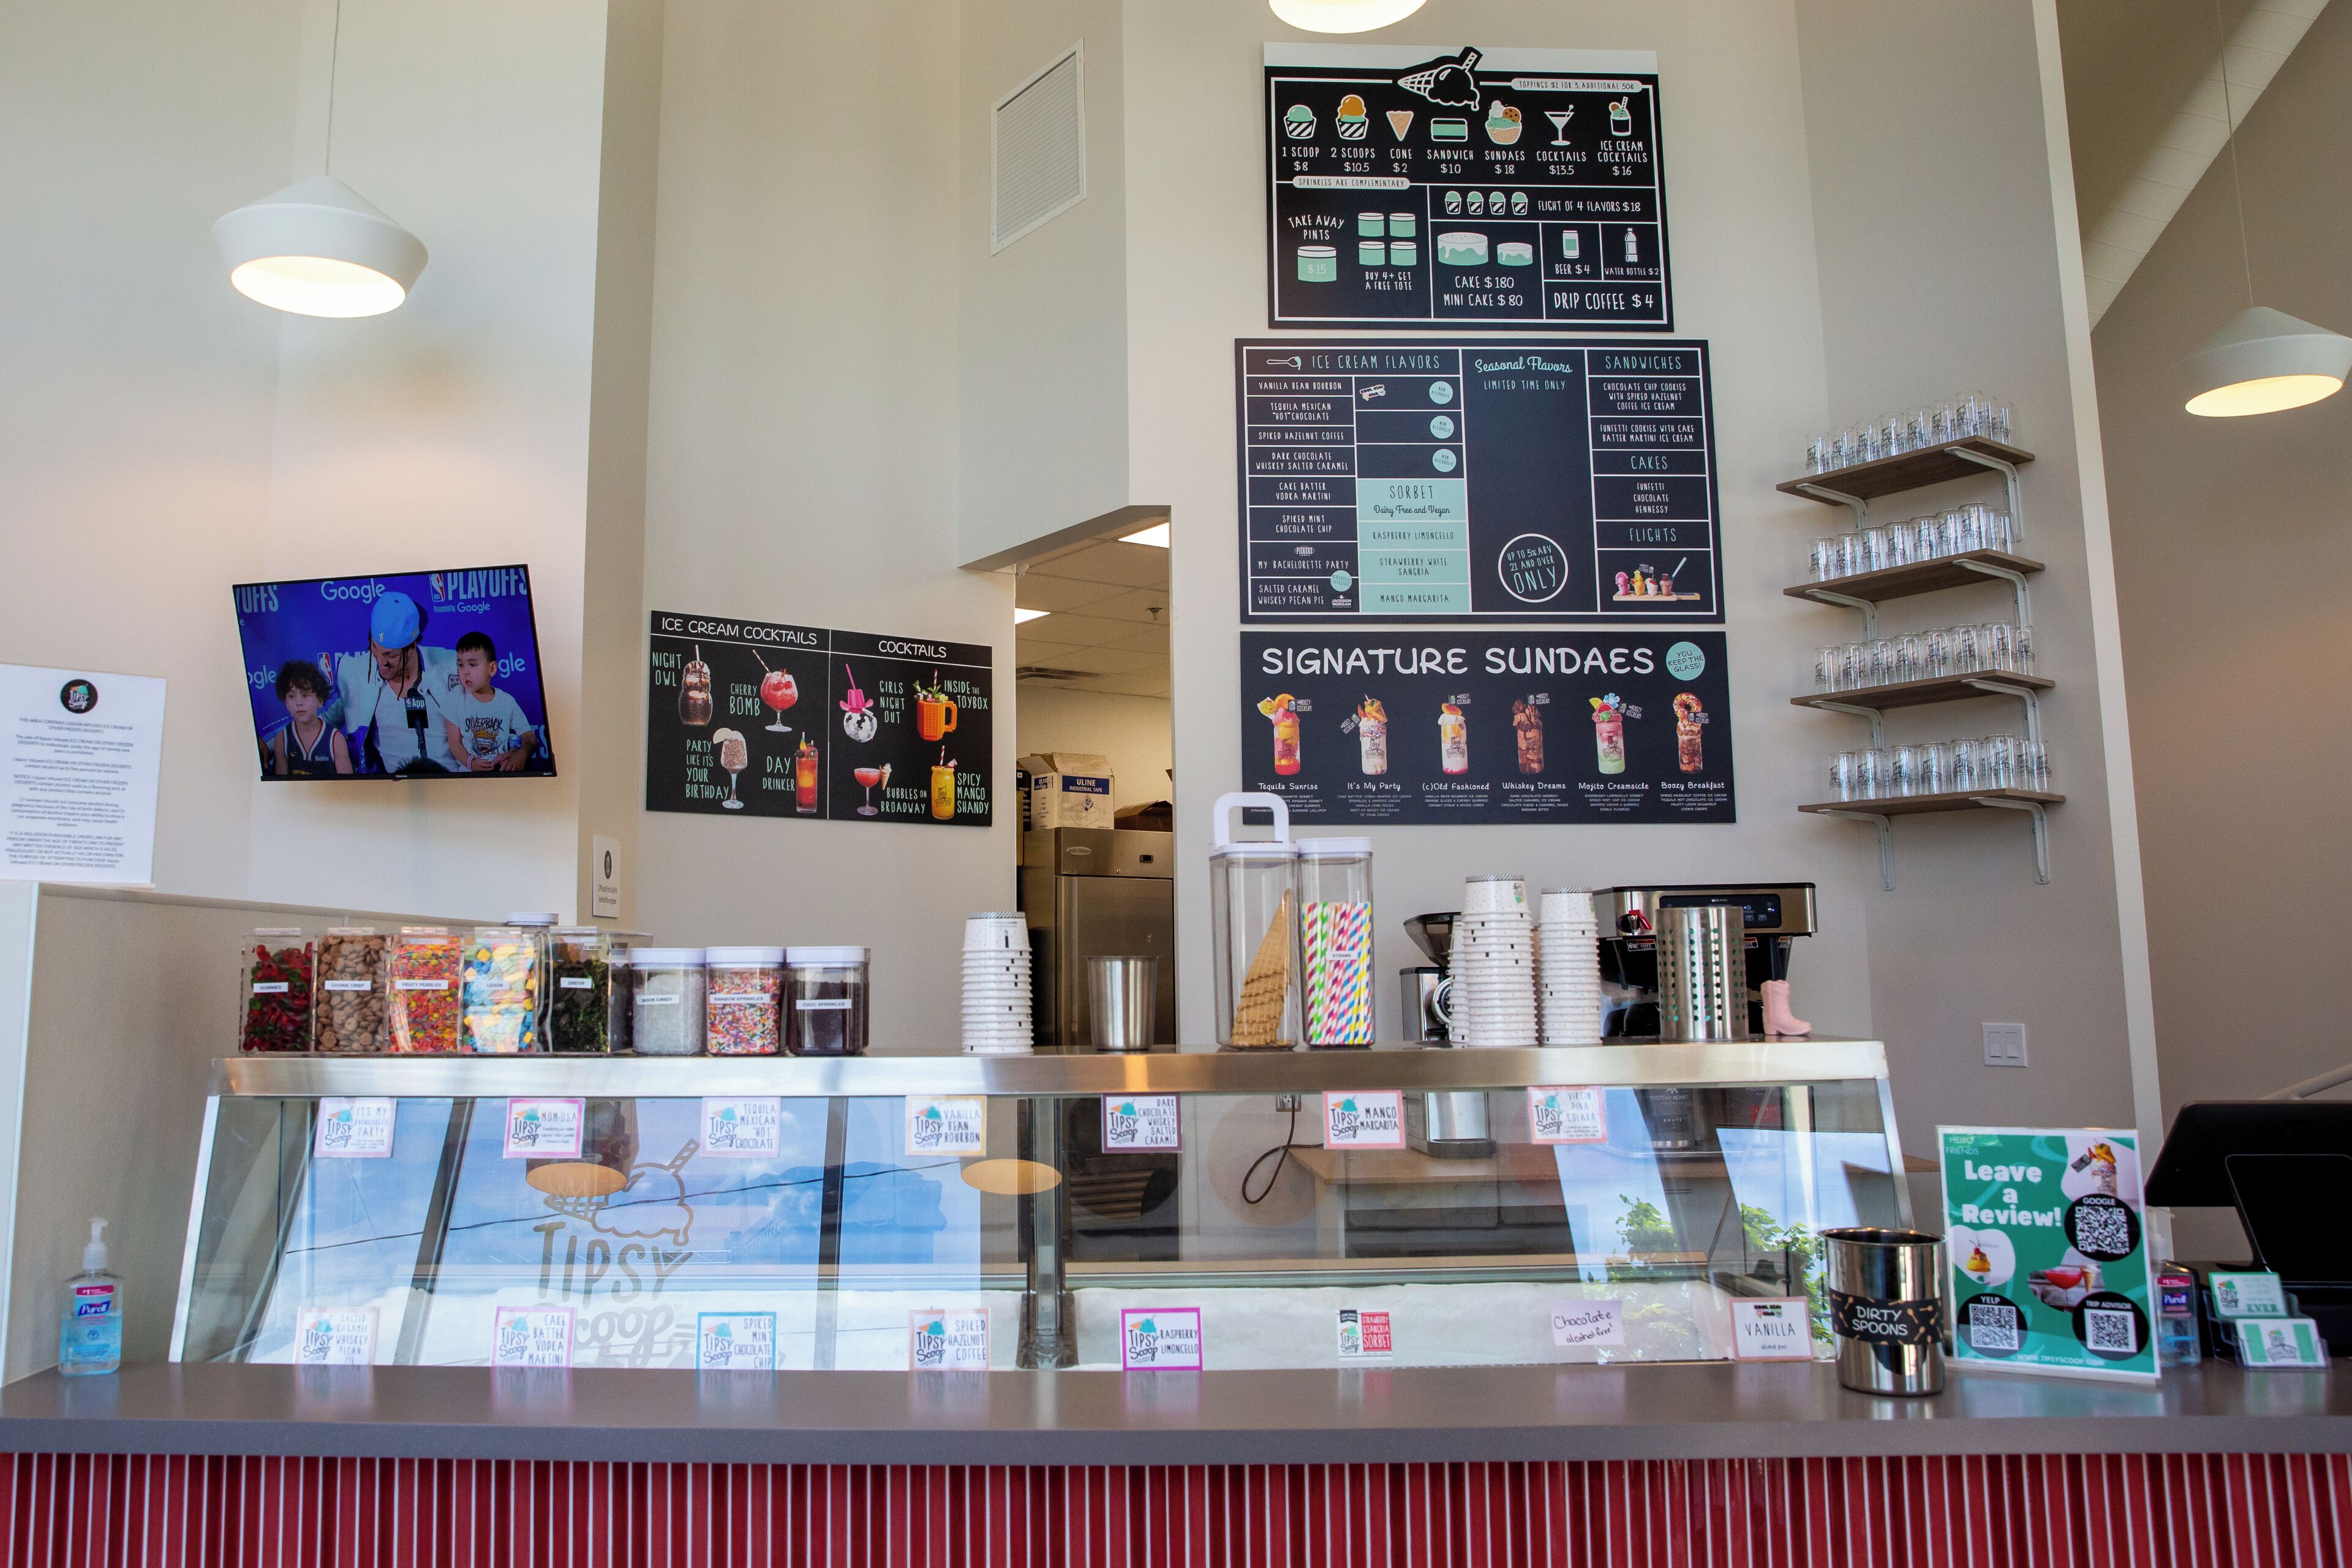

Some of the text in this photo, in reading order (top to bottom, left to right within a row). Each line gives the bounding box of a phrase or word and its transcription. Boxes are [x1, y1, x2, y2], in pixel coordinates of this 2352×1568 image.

[1283, 147, 1319, 157] 1 SCOOP
[1601, 141, 1643, 151] ICE CREAM
[1331, 148, 1375, 158] 2 SCOOPS
[1390, 149, 1412, 159] CONE
[1427, 149, 1473, 160] SANDWICH
[1485, 151, 1525, 160] SUNDAES
[1537, 151, 1586, 161] COCKTAILS
[1598, 152, 1647, 162] COCKTAILS
[1294, 161, 1308, 171] $8
[1344, 162, 1369, 172] $10.5
[1441, 164, 1461, 173] $10
[1550, 165, 1574, 175] $13.5
[1539, 201, 1640, 211] FLIGHT OF 4 FLAVORS $18
[1288, 215, 1344, 228] TAKE AWAY
[1304, 230, 1329, 239] PINTS
[1455, 276, 1513, 288] CAKE $180
[1444, 294, 1463, 306] MINI
[1469, 294, 1493, 306] CAKE
[1555, 293, 1579, 309] DRIP
[1586, 293, 1624, 309] COFFEE
[1313, 355, 1439, 368] ICE CREAM FLAVORS
[1475, 356, 1572, 372] Seasonal Flavors
[1606, 356, 1681, 369] SANDWICHES
[1484, 380, 1564, 390] LIMITED TIME ONLY
[1631, 456, 1667, 469] CAKES
[1390, 486, 1432, 499] SORBET
[1374, 505, 1394, 517] Dairy
[1428, 505, 1450, 517] Vegan
[1630, 529, 1676, 541] FLIGHTS
[1517, 550, 1525, 559] TO
[1539, 545, 1551, 555] ABV
[1521, 559, 1534, 569] AND
[1537, 556, 1555, 566] OVER
[1514, 566, 1555, 594] ONLY
[321, 578, 386, 603] Google
[458, 601, 490, 613] Google
[662, 617, 816, 644] ICE CREAM COCKTAILS
[879, 641, 946, 658] COCKTAILS
[653, 652, 681, 669] NIGHT
[1263, 648, 1468, 674] SIGNATURE
[1486, 647, 1654, 674] SUNDAES
[656, 670, 676, 686] OWL
[731, 684, 756, 696] CHERRY
[880, 680, 903, 693] GIRLS
[944, 680, 970, 694] INSIDE
[412, 699, 424, 708] App
[730, 696, 760, 716] BOMB
[880, 696, 904, 710] NIGHT
[957, 695, 987, 709] TOYBOX
[884, 710, 900, 723] OUT
[687, 740, 711, 752] PARTY
[687, 754, 713, 766] LIKE IT'S
[767, 756, 790, 774] DAY
[687, 767, 708, 782] YOUR
[958, 773, 980, 786] SPICY
[763, 778, 794, 791] DRINKER
[1364, 783, 1376, 791] My
[1380, 782, 1400, 791] Party
[1502, 782, 1534, 791] Whiskey
[1579, 783, 1604, 791] Mojito
[1662, 782, 1724, 791] Boozy Breakfast
[686, 784, 728, 799] BIRTHDAY
[957, 787, 985, 800] MANGO
[957, 801, 989, 814] SHANDY
[1365, 1107, 1396, 1118] MANGO
[1110, 1112, 1138, 1129] TIPSY
[1360, 1121, 1399, 1130] MARGARITA
[1110, 1128, 1137, 1142] Scoop
[1965, 1160, 2041, 1182] Leave
[2003, 1188, 2018, 1204] a
[2083, 1197, 2116, 1206] GOOGLE
[1962, 1204, 2062, 1227] Review!
[533, 1221, 693, 1310] TIPSY
[1856, 1306, 1902, 1321] DIRTY
[1745, 1323, 1795, 1336] VANILLA
[1853, 1319, 1908, 1335] SPOONS
[1161, 1329, 1197, 1340] RASPBERRY
[1161, 1344, 1199, 1354] LIMONCELLO
